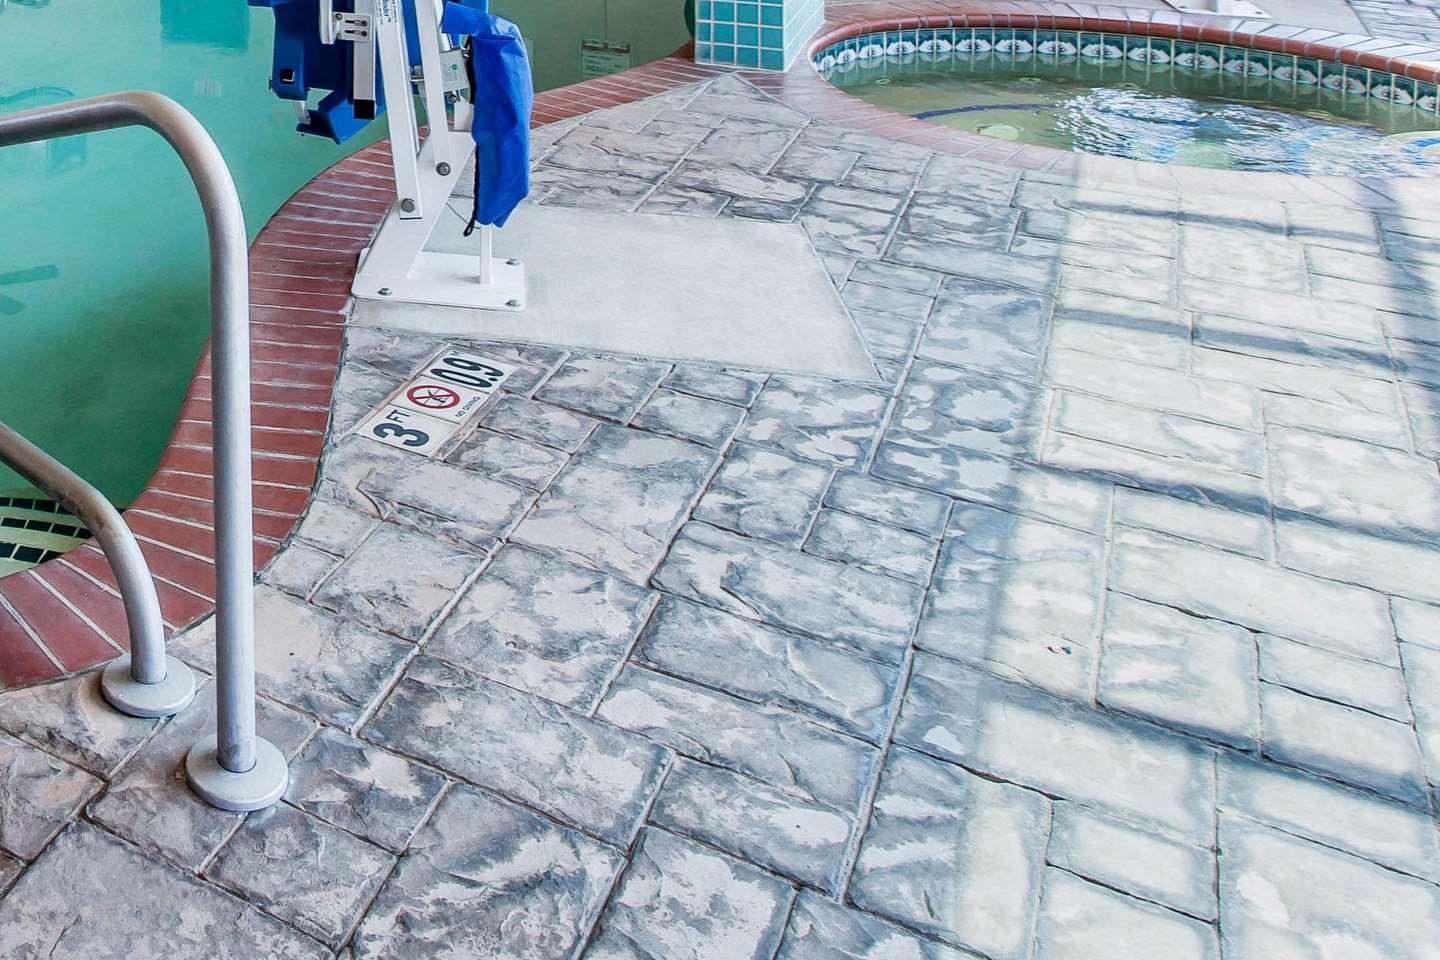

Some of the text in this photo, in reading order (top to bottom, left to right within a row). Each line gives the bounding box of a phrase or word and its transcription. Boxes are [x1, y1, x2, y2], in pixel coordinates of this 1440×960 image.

[430, 357, 505, 388] 0.9
[373, 409, 430, 447] 3 FT
